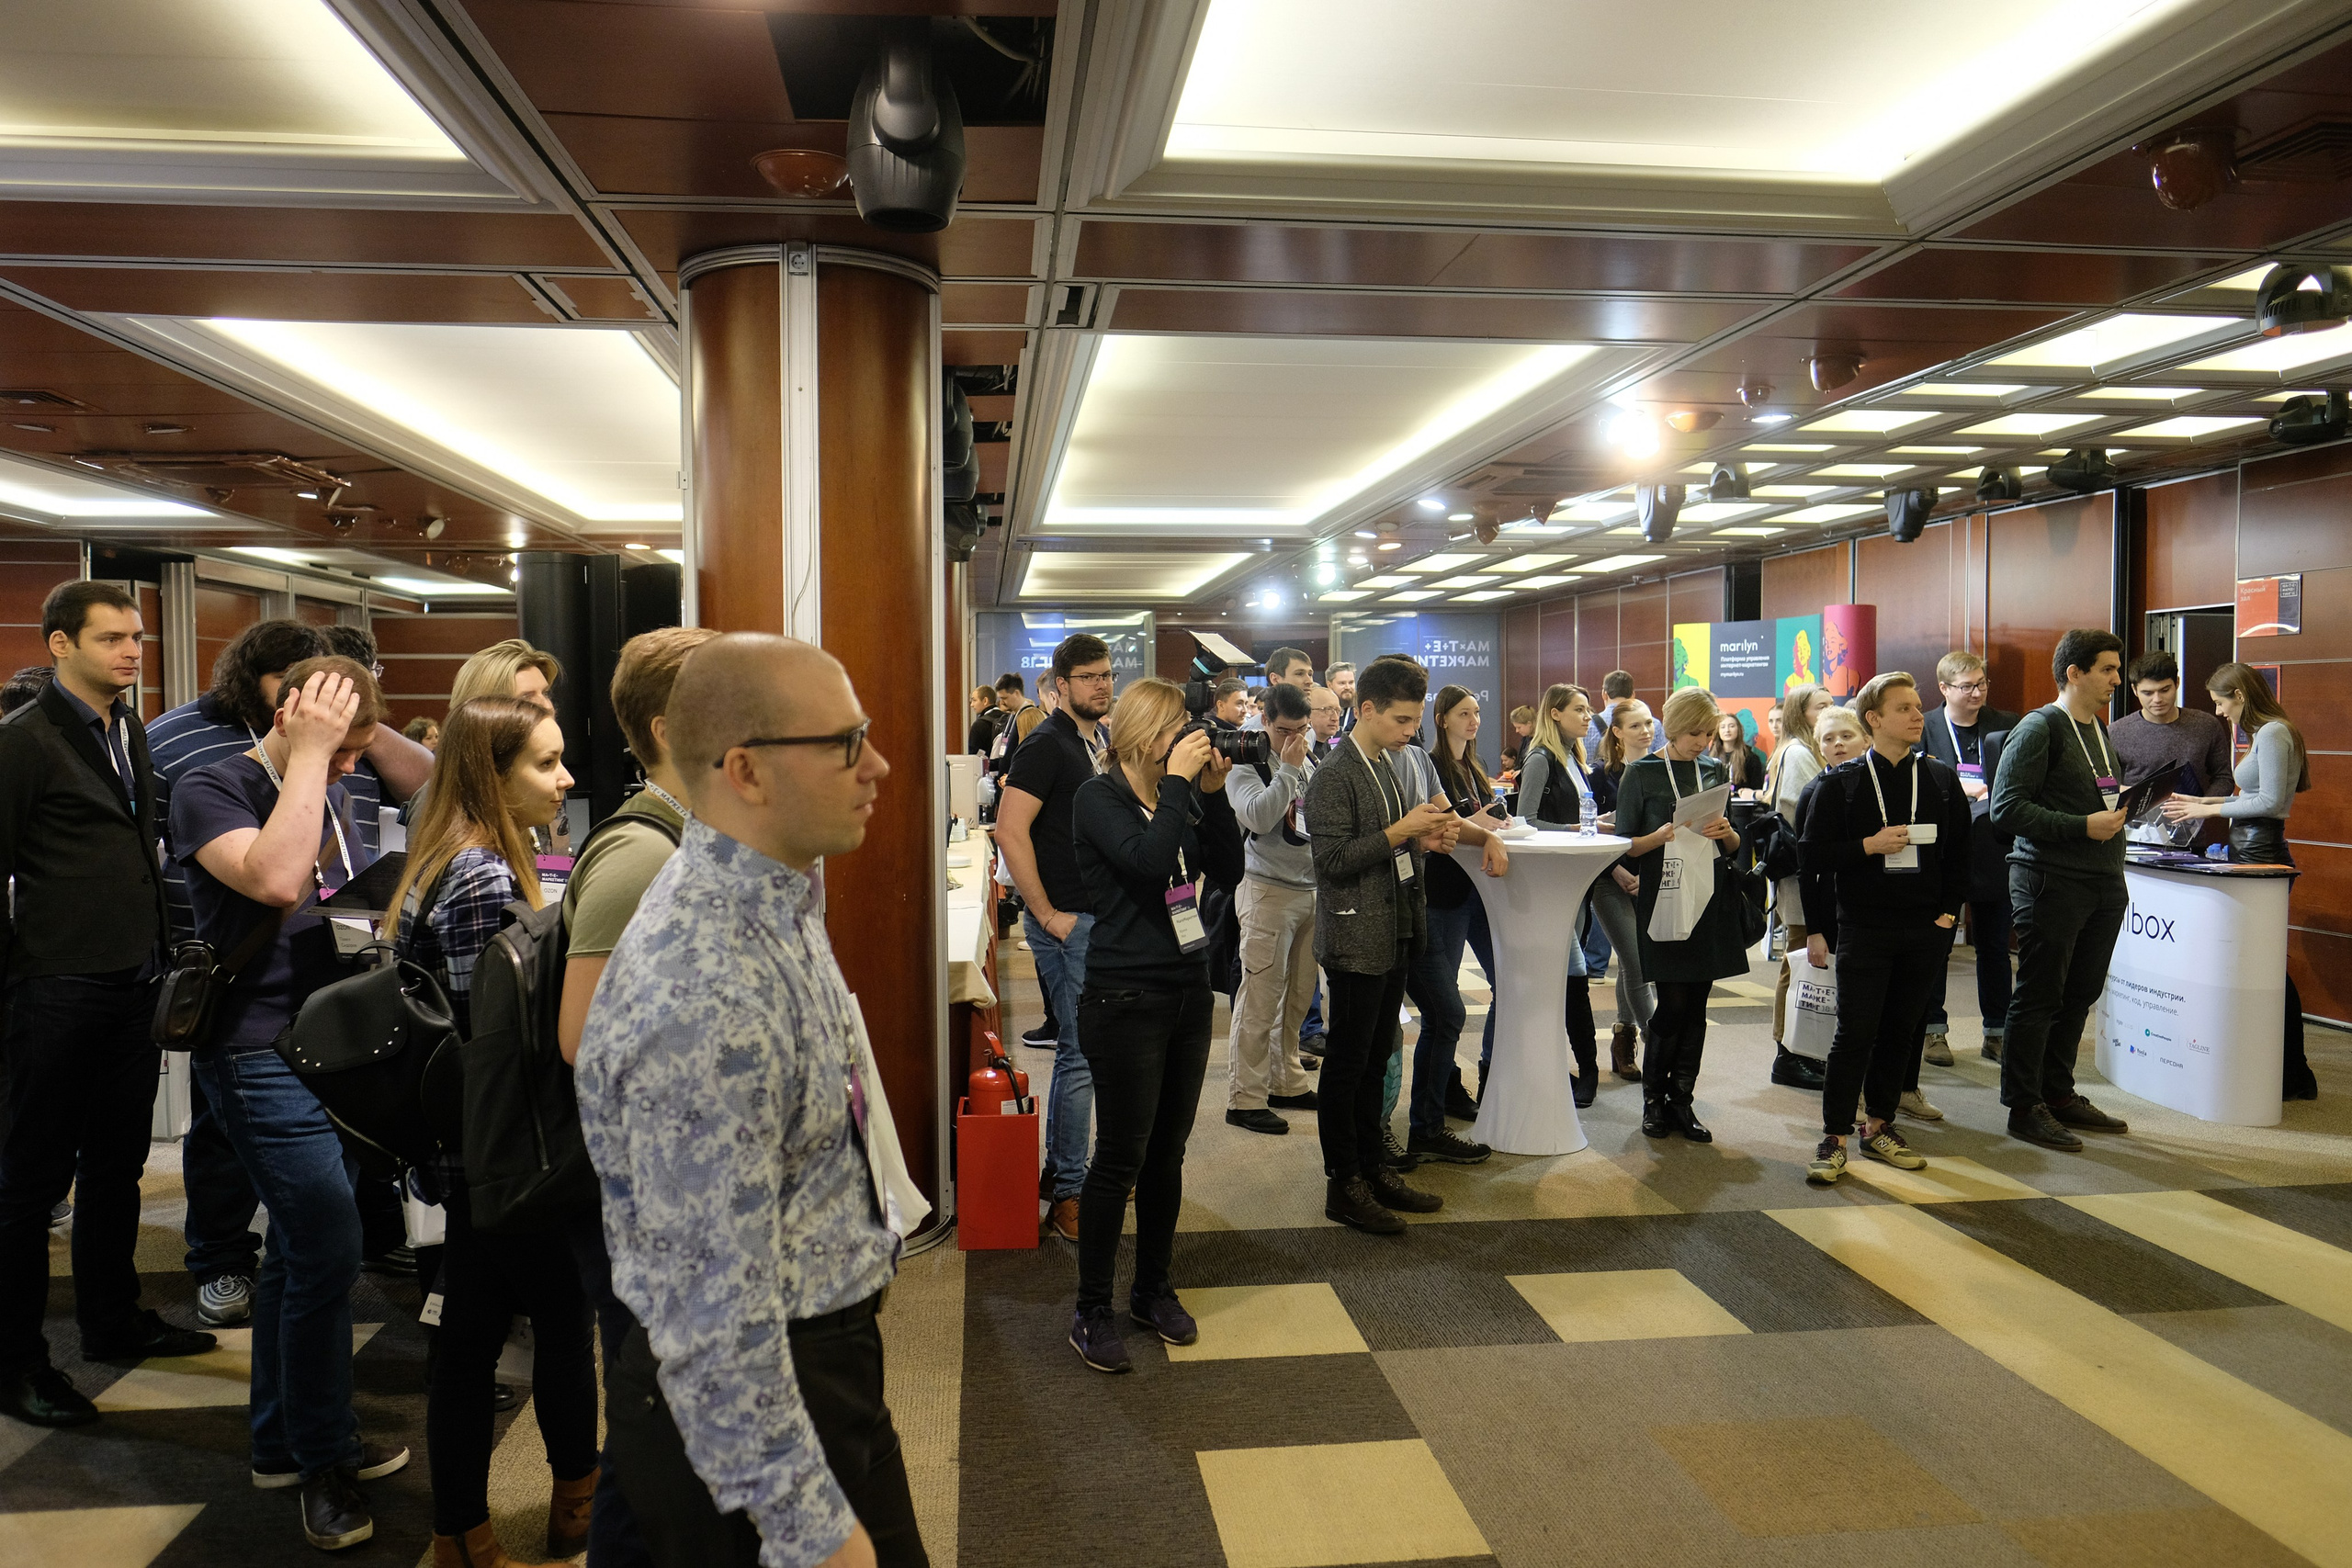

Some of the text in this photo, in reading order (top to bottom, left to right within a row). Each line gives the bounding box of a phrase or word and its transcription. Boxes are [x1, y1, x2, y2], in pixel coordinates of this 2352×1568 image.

[1720, 638, 1758, 654] marilyn
[2125, 980, 2148, 993] лидеров
[2149, 987, 2187, 1003] индустрии.
[2142, 1000, 2179, 1016] управление.
